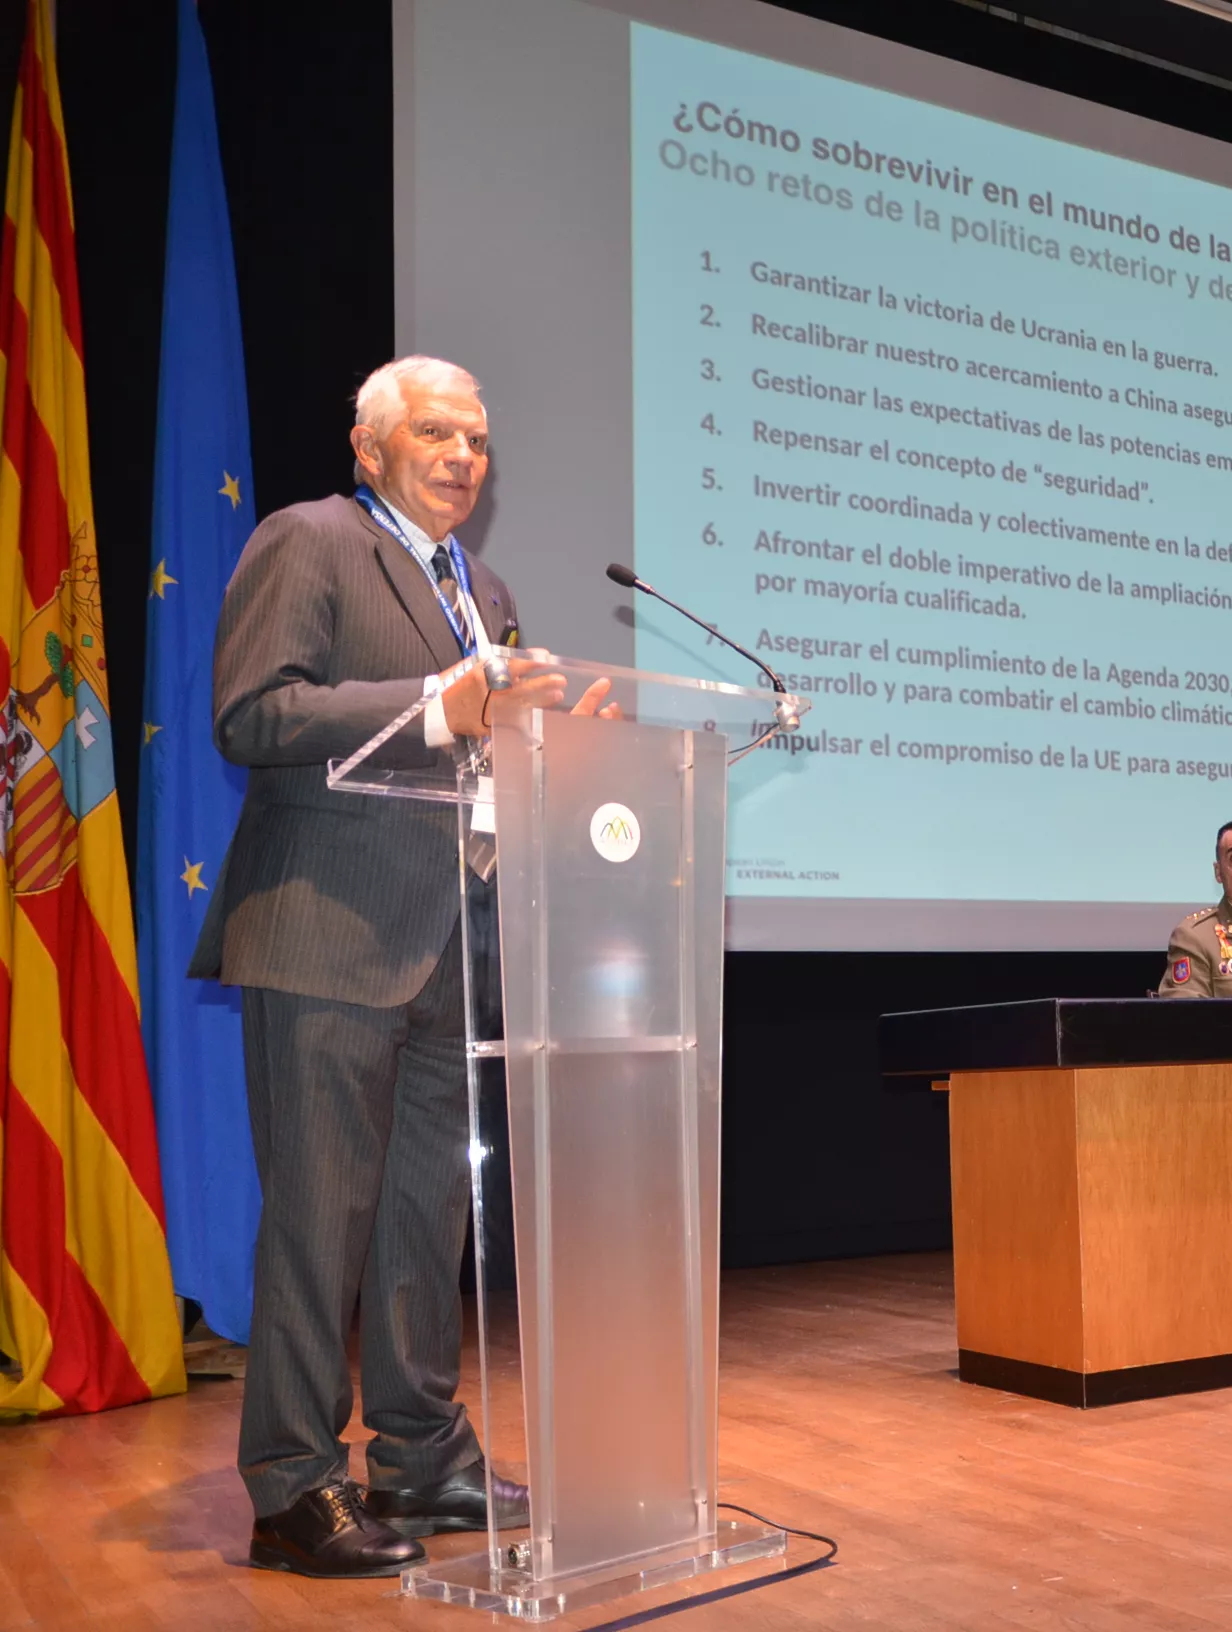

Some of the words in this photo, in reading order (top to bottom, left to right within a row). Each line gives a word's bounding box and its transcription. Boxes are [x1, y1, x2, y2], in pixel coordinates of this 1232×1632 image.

[673, 101, 801, 153] ¿Cómo
[811, 137, 974, 197] sobrevivir
[982, 181, 1019, 209] en
[1028, 191, 1053, 217] el
[1063, 201, 1161, 244] mundo
[1168, 225, 1201, 255] de
[1209, 233, 1232, 263] la
[658, 138, 756, 187] Ocho
[767, 170, 854, 211] retos
[864, 190, 904, 223] de
[914, 199, 941, 232] la
[951, 215, 1061, 261] política
[1069, 244, 1177, 288] exterior
[1185, 272, 1200, 300] y
[700, 250, 721, 274] 1.
[749, 261, 872, 305] Garantizar
[878, 285, 898, 310] la
[903, 293, 984, 329] victoria
[989, 310, 1016, 335] de
[1021, 317, 1097, 352] Ucrania
[1102, 339, 1127, 359] en
[1131, 339, 1149, 363] la
[1153, 350, 1219, 378] guerra.
[699, 303, 721, 328] 2.
[751, 313, 869, 355] Recalibrar
[875, 342, 960, 373] nuestro
[965, 360, 1103, 400] acercamiento
[1108, 388, 1120, 404] a
[1124, 387, 1178, 416] China
[700, 358, 722, 382] 3.
[751, 368, 867, 407] Gestionar
[873, 386, 904, 414] las
[909, 400, 1042, 438] expectativas
[1047, 419, 1072, 443] de
[1077, 423, 1105, 449] las
[1110, 435, 1201, 466] potencias
[700, 412, 722, 437] 4.
[752, 419, 864, 458] Repensar
[869, 439, 890, 463] el
[895, 448, 996, 479] concepto
[1000, 459, 1028, 484] de
[371, 508, 400, 536] DEFENSA
[400, 537, 410, 548] DE
[701, 467, 723, 491] 5.
[754, 474, 841, 507] Invertir
[847, 493, 973, 526] coordinada
[978, 511, 992, 533] y
[997, 511, 1151, 551] colectivamente
[1155, 538, 1179, 556] en
[1183, 536, 1201, 559] la
[701, 521, 724, 547] 6.
[753, 529, 855, 562] Afrontar
[861, 542, 882, 566] el
[888, 545, 952, 575] doble
[957, 553, 1072, 589] imperativo
[1076, 570, 1102, 593] de
[1107, 573, 1125, 596] la
[1130, 581, 1232, 610] ampliación
[754, 573, 797, 595] por
[803, 578, 898, 605] mayoría
[903, 587, 1027, 620] cualificada.
[756, 628, 863, 660] Asegurar
[868, 638, 889, 662] el
[895, 646, 1047, 676] cumplimiento
[1051, 656, 1078, 680] de
[1083, 658, 1101, 682] la
[1106, 662, 1180, 689] Agenda
[883, 681, 897, 704] y
[903, 683, 953, 705] para
[958, 685, 1055, 711] combatir
[1059, 691, 1079, 714] el
[1083, 695, 1157, 720] cambio
[869, 733, 890, 758] el
[896, 740, 1034, 766] compromiso
[1039, 744, 1065, 768] de
[1070, 745, 1089, 769] la
[1094, 749, 1122, 772] UE
[1127, 756, 1171, 777] para
[736, 869, 795, 880] EXTERNAL
[798, 870, 840, 880] ACTION
